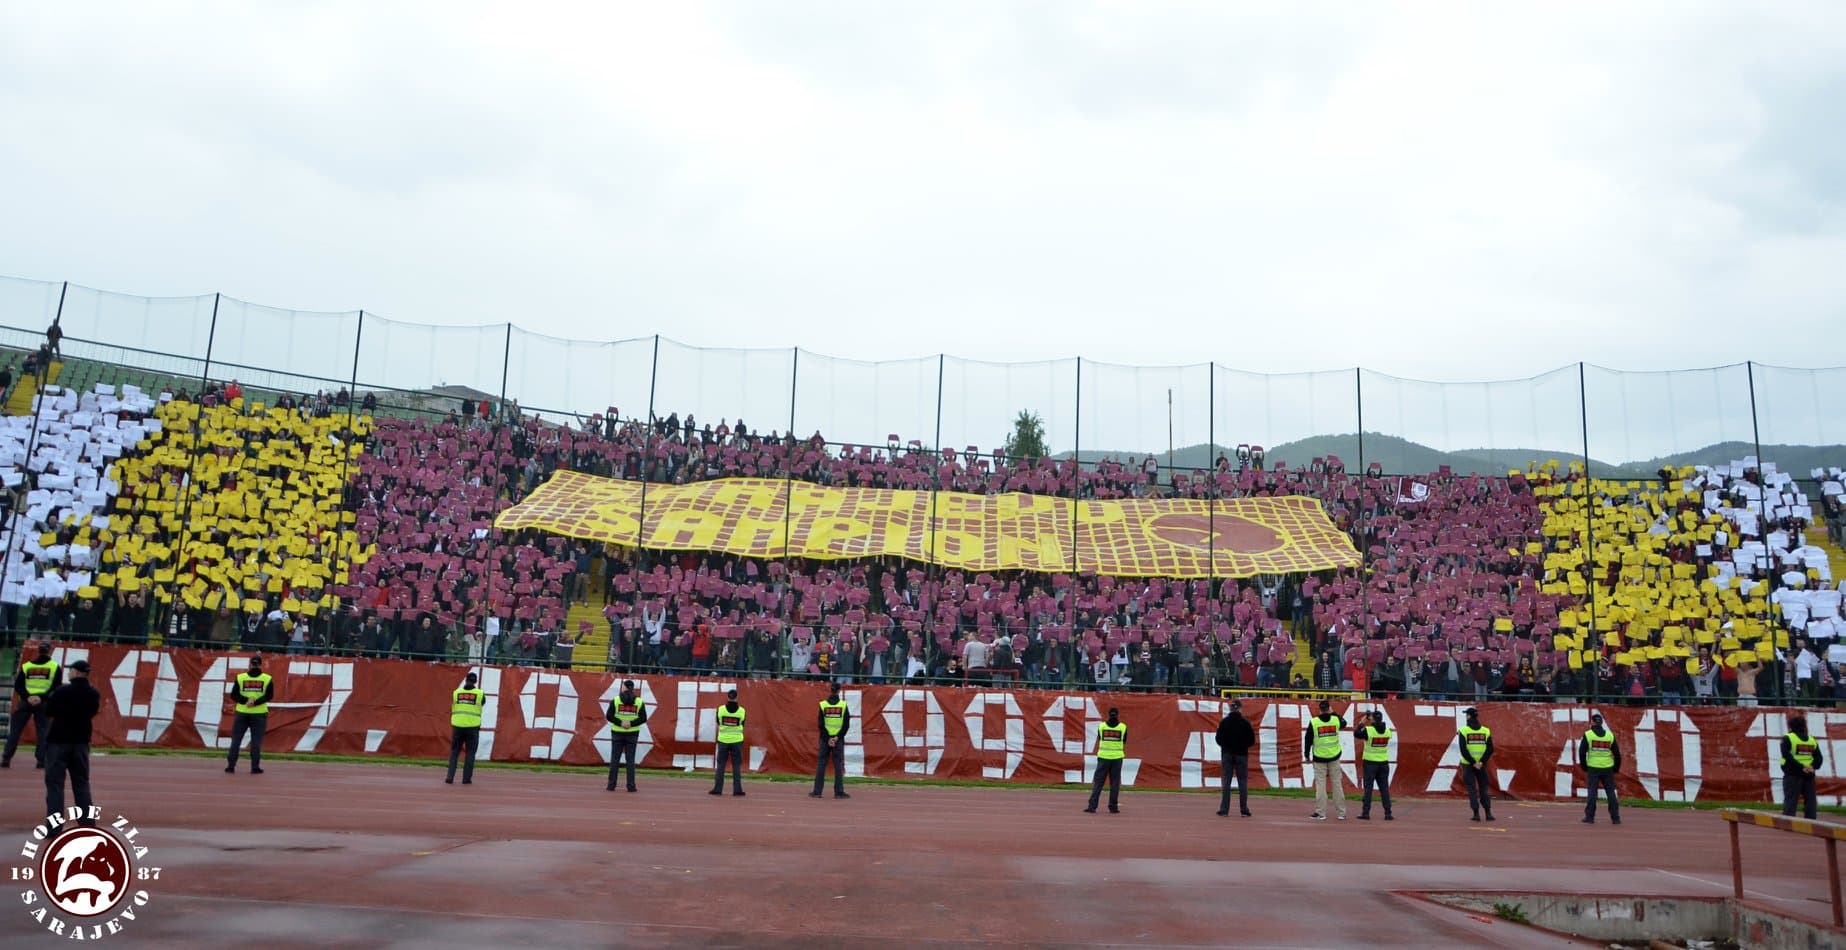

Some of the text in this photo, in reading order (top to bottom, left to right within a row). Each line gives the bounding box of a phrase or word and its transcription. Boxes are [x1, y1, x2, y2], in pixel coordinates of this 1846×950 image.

[460, 667, 767, 771] 1985.
[840, 689, 1142, 786] 1999.
[1178, 699, 1516, 791] 2007.
